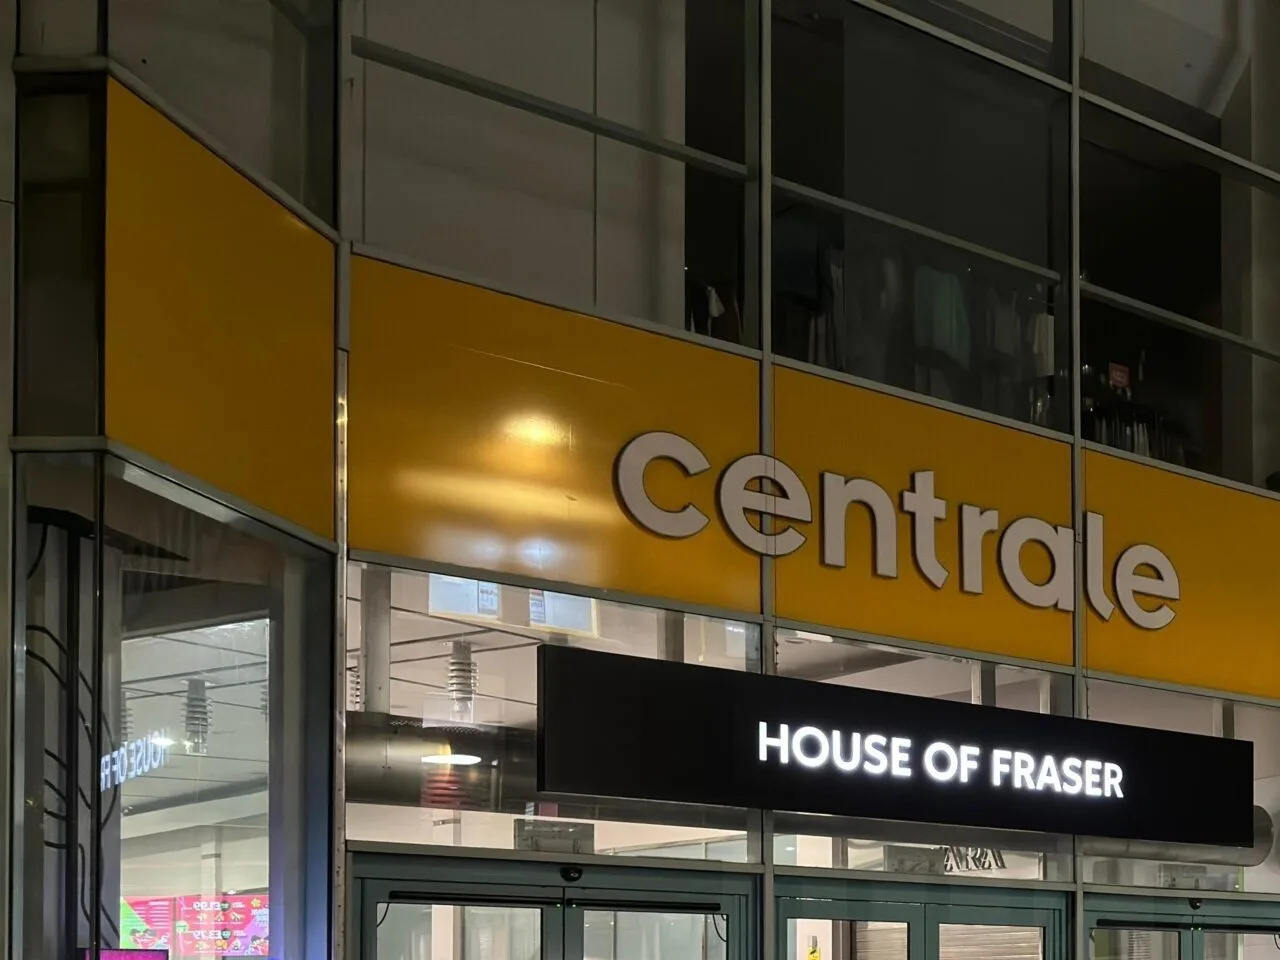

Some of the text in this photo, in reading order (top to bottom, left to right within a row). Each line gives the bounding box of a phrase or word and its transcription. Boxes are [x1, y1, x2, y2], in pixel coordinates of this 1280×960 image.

[616, 430, 1181, 630] centrale
[757, 720, 1125, 799] HOUSE OF FRASER
